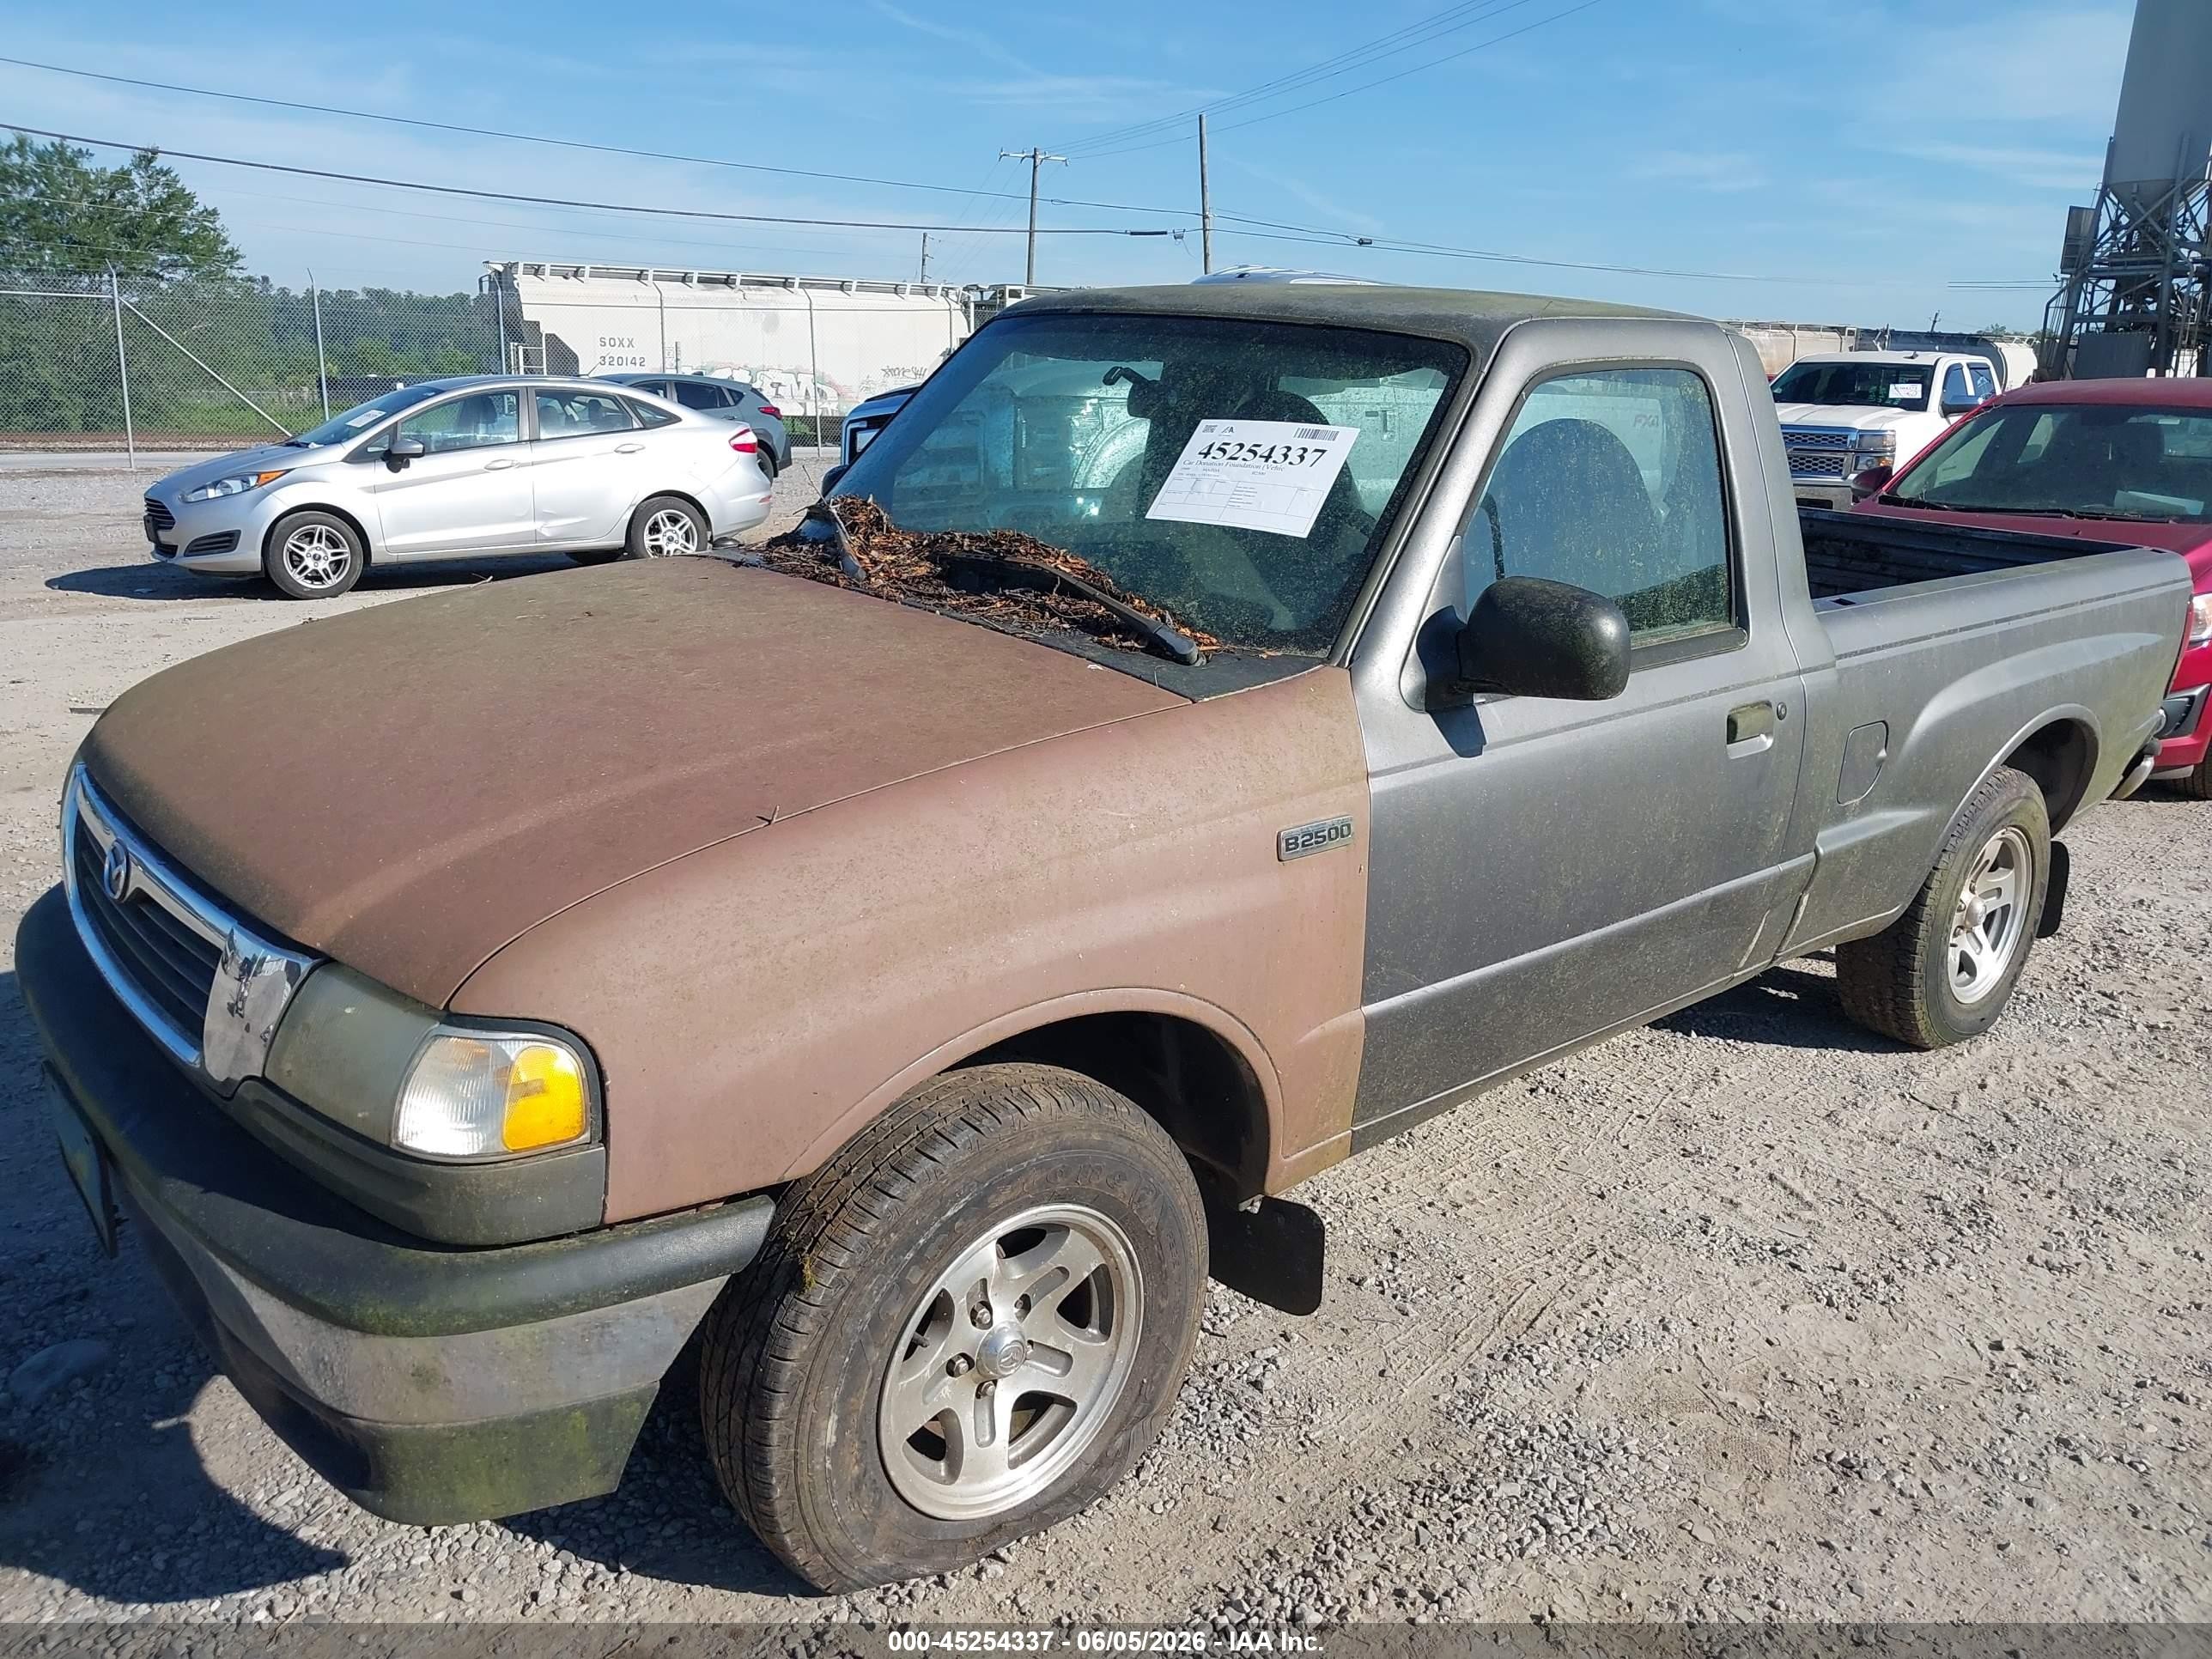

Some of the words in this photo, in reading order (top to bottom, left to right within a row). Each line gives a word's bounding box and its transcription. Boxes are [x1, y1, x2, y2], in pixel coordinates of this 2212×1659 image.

[599, 337, 635, 349] SOXX
[599, 356, 646, 367] 320142
[1198, 441, 1328, 468] 45254337
[1224, 461, 1261, 470] Foundation
[1285, 823, 1352, 853] B2500
